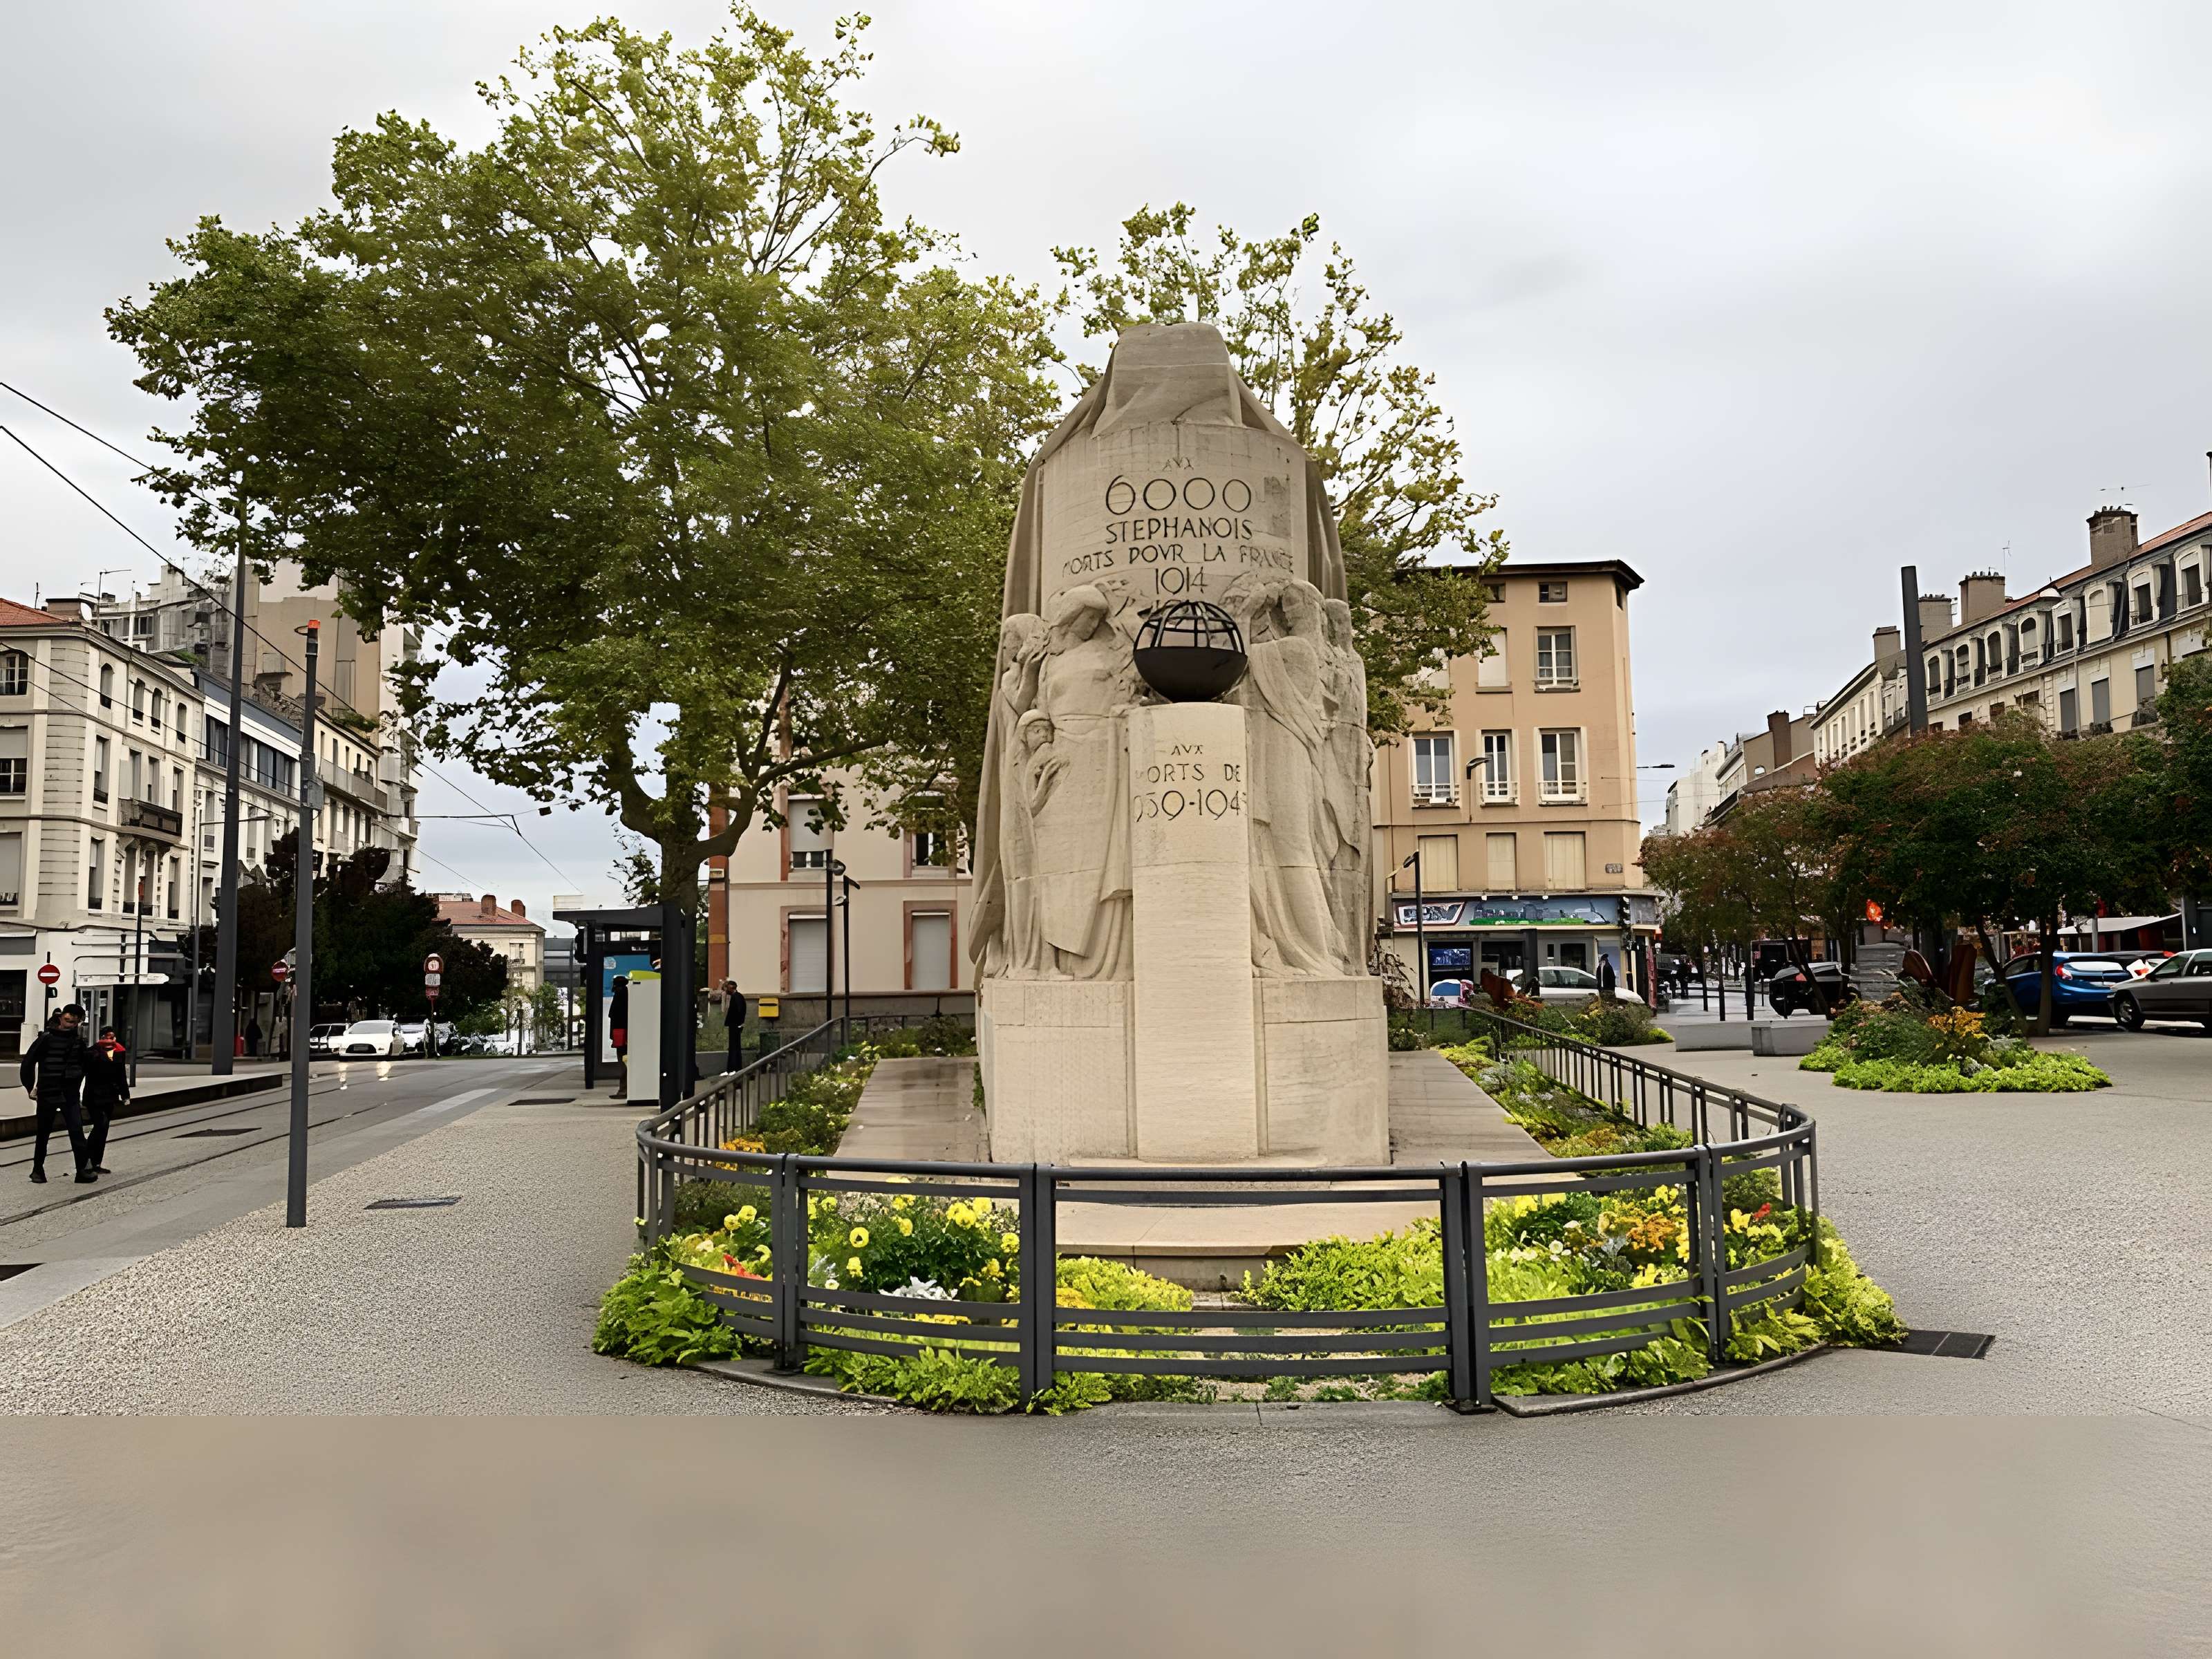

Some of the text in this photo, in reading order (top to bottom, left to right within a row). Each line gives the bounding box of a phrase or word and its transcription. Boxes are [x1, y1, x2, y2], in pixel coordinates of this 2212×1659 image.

[1105, 474, 1252, 515] 6000
[1105, 516, 1253, 544] STEPHANOIS
[1203, 543, 1226, 562] LA
[1135, 762, 1205, 783] ORTS
